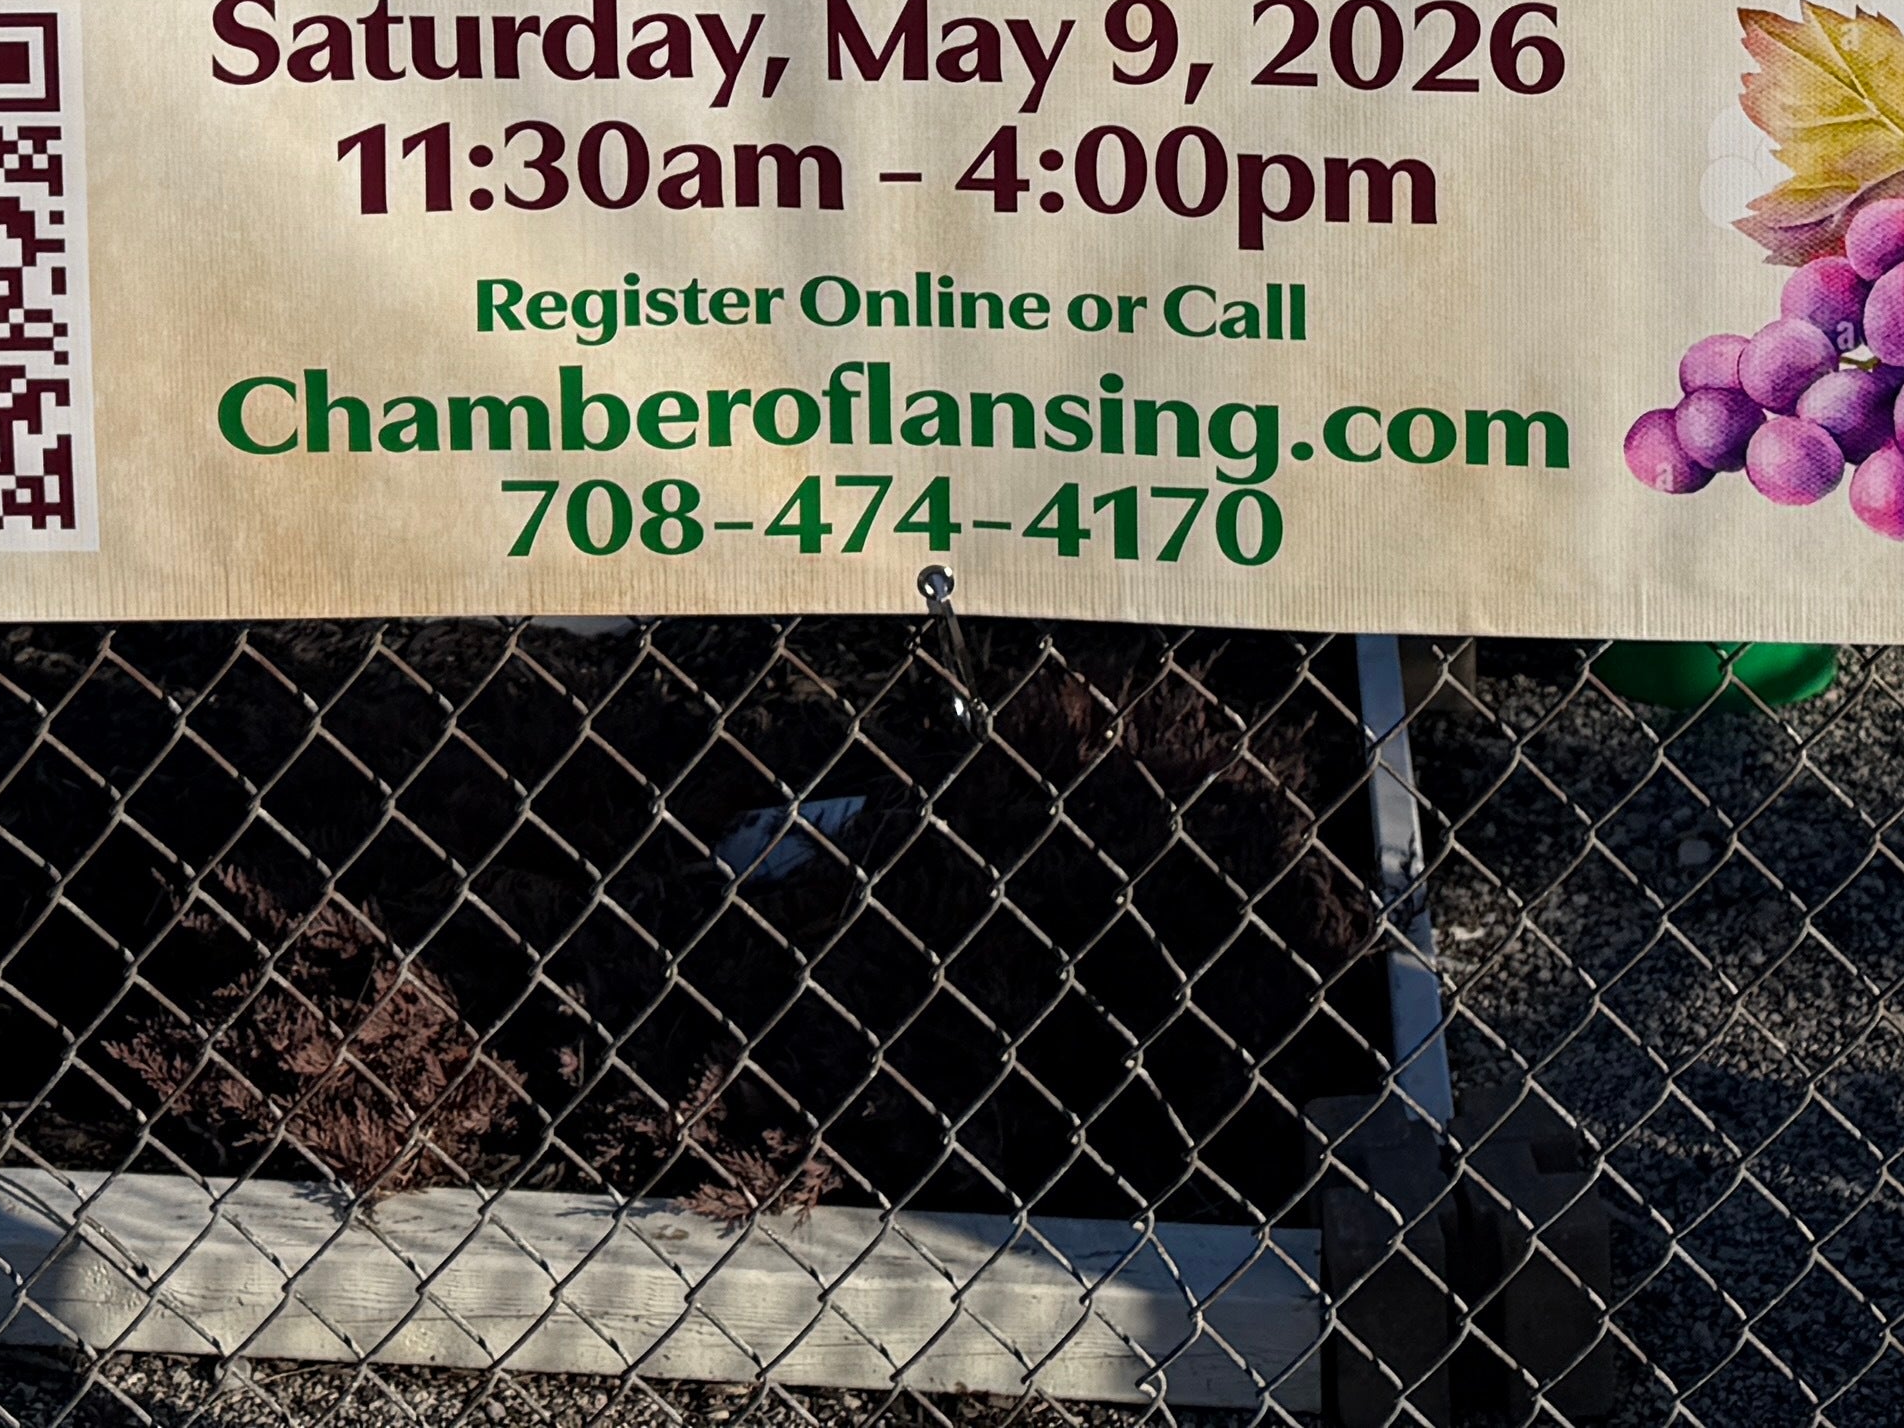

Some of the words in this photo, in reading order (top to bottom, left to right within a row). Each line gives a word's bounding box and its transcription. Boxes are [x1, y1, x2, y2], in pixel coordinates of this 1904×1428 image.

[338, 121, 844, 214] 11:30am
[955, 125, 1437, 250] 4:00pm
[478, 274, 784, 346] Register
[802, 273, 1050, 329] Online
[1068, 296, 1147, 333] or
[1165, 284, 1306, 340] Call
[218, 363, 1570, 484] Chamberoflansing.com
[500, 476, 1284, 567] 708-474-4170
